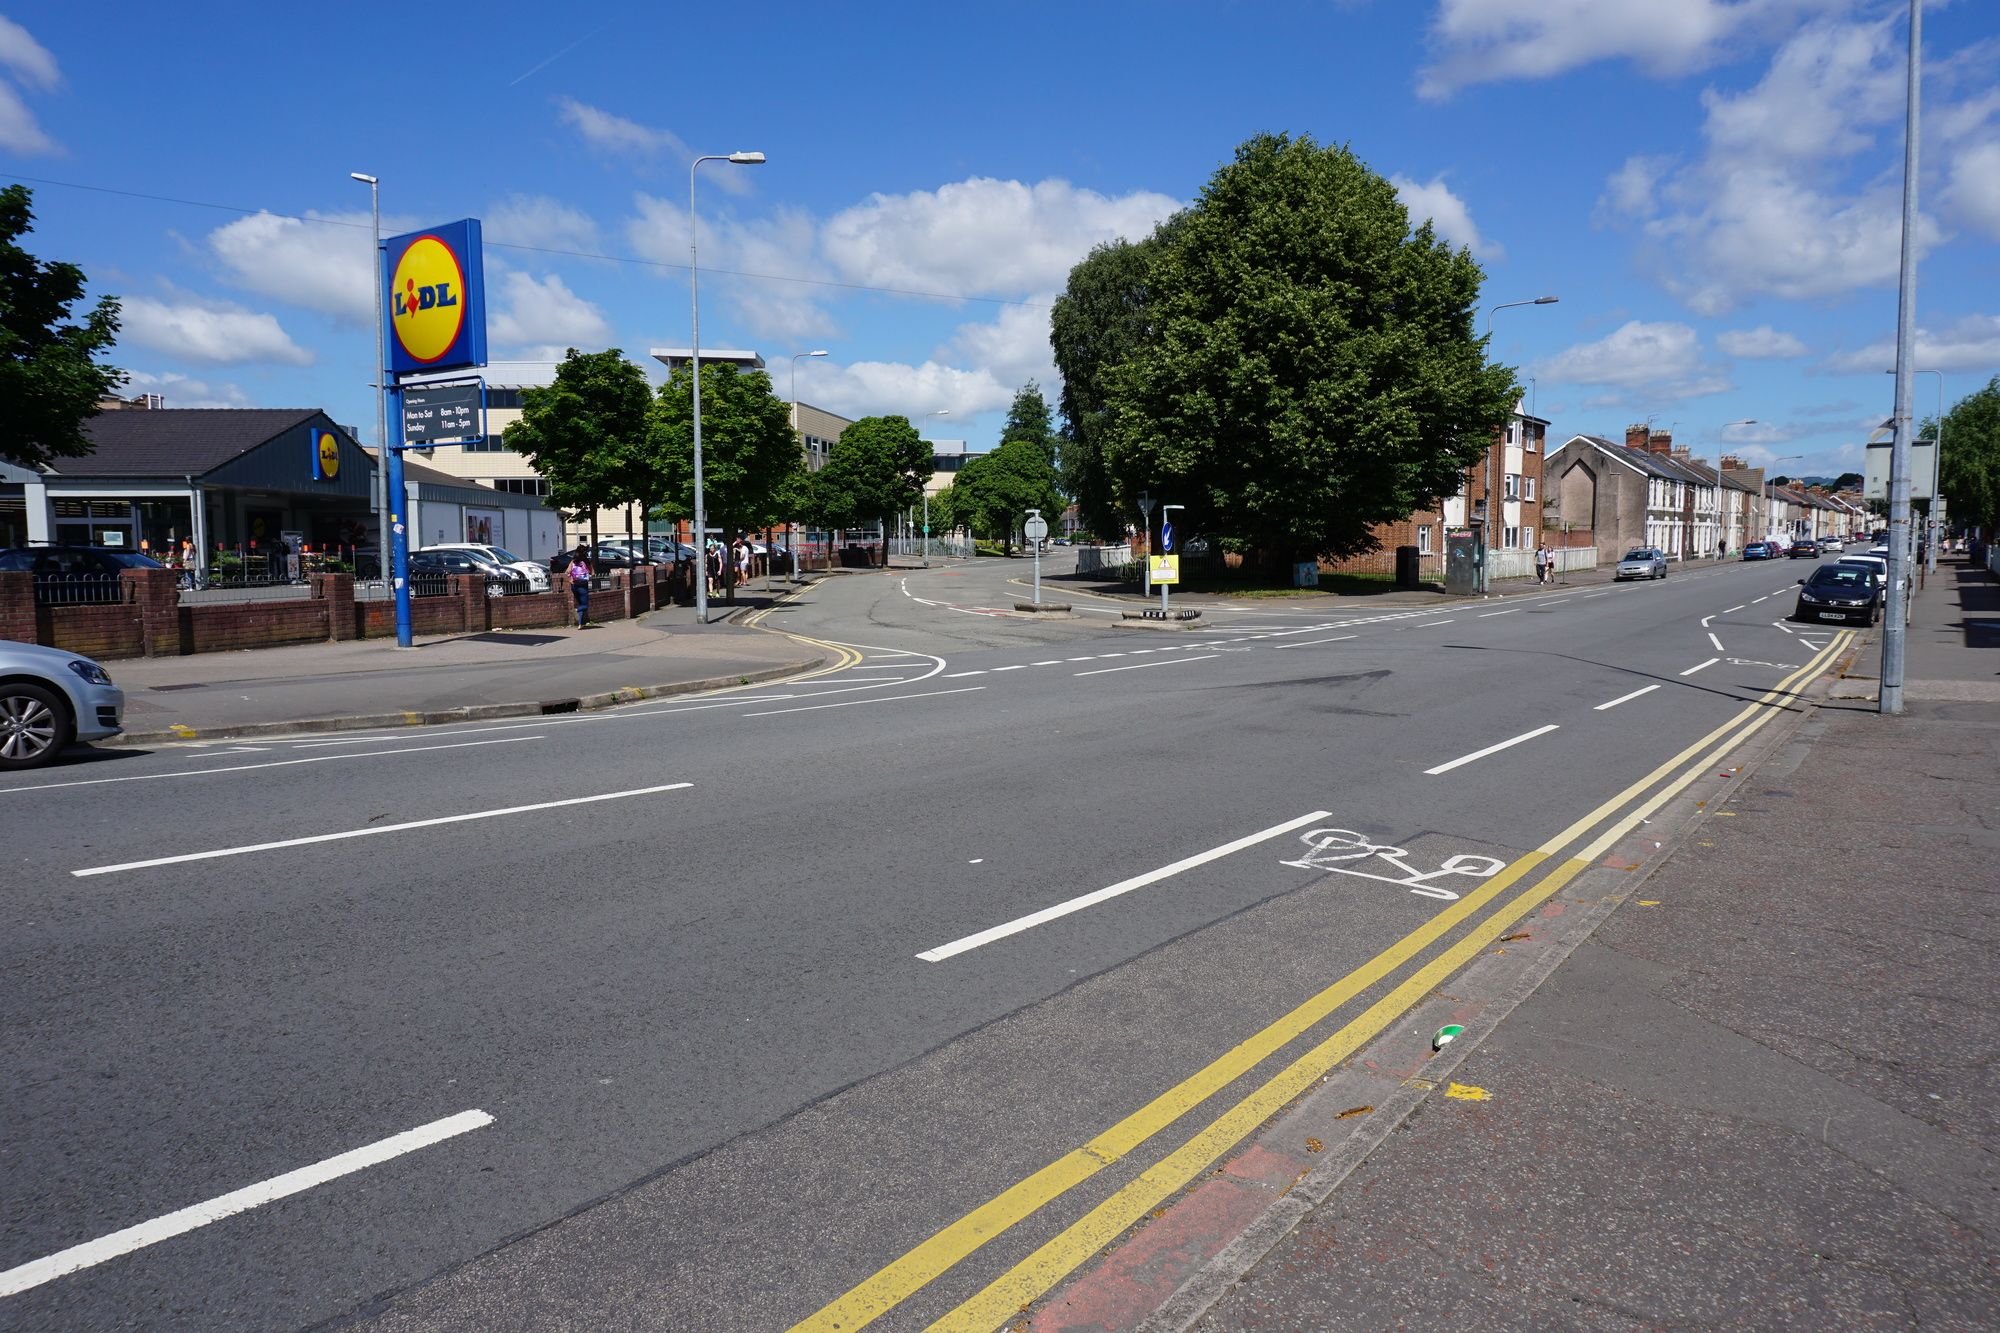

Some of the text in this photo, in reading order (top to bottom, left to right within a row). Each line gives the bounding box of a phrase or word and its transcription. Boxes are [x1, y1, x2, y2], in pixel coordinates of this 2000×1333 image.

[406, 411, 418, 419] Mon
[424, 410, 433, 418] Sat
[440, 408, 452, 416] 8am
[455, 406, 470, 417] 10pm
[406, 423, 425, 432] Sunday
[441, 420, 455, 428] 11am
[458, 418, 471, 429] 5pm
